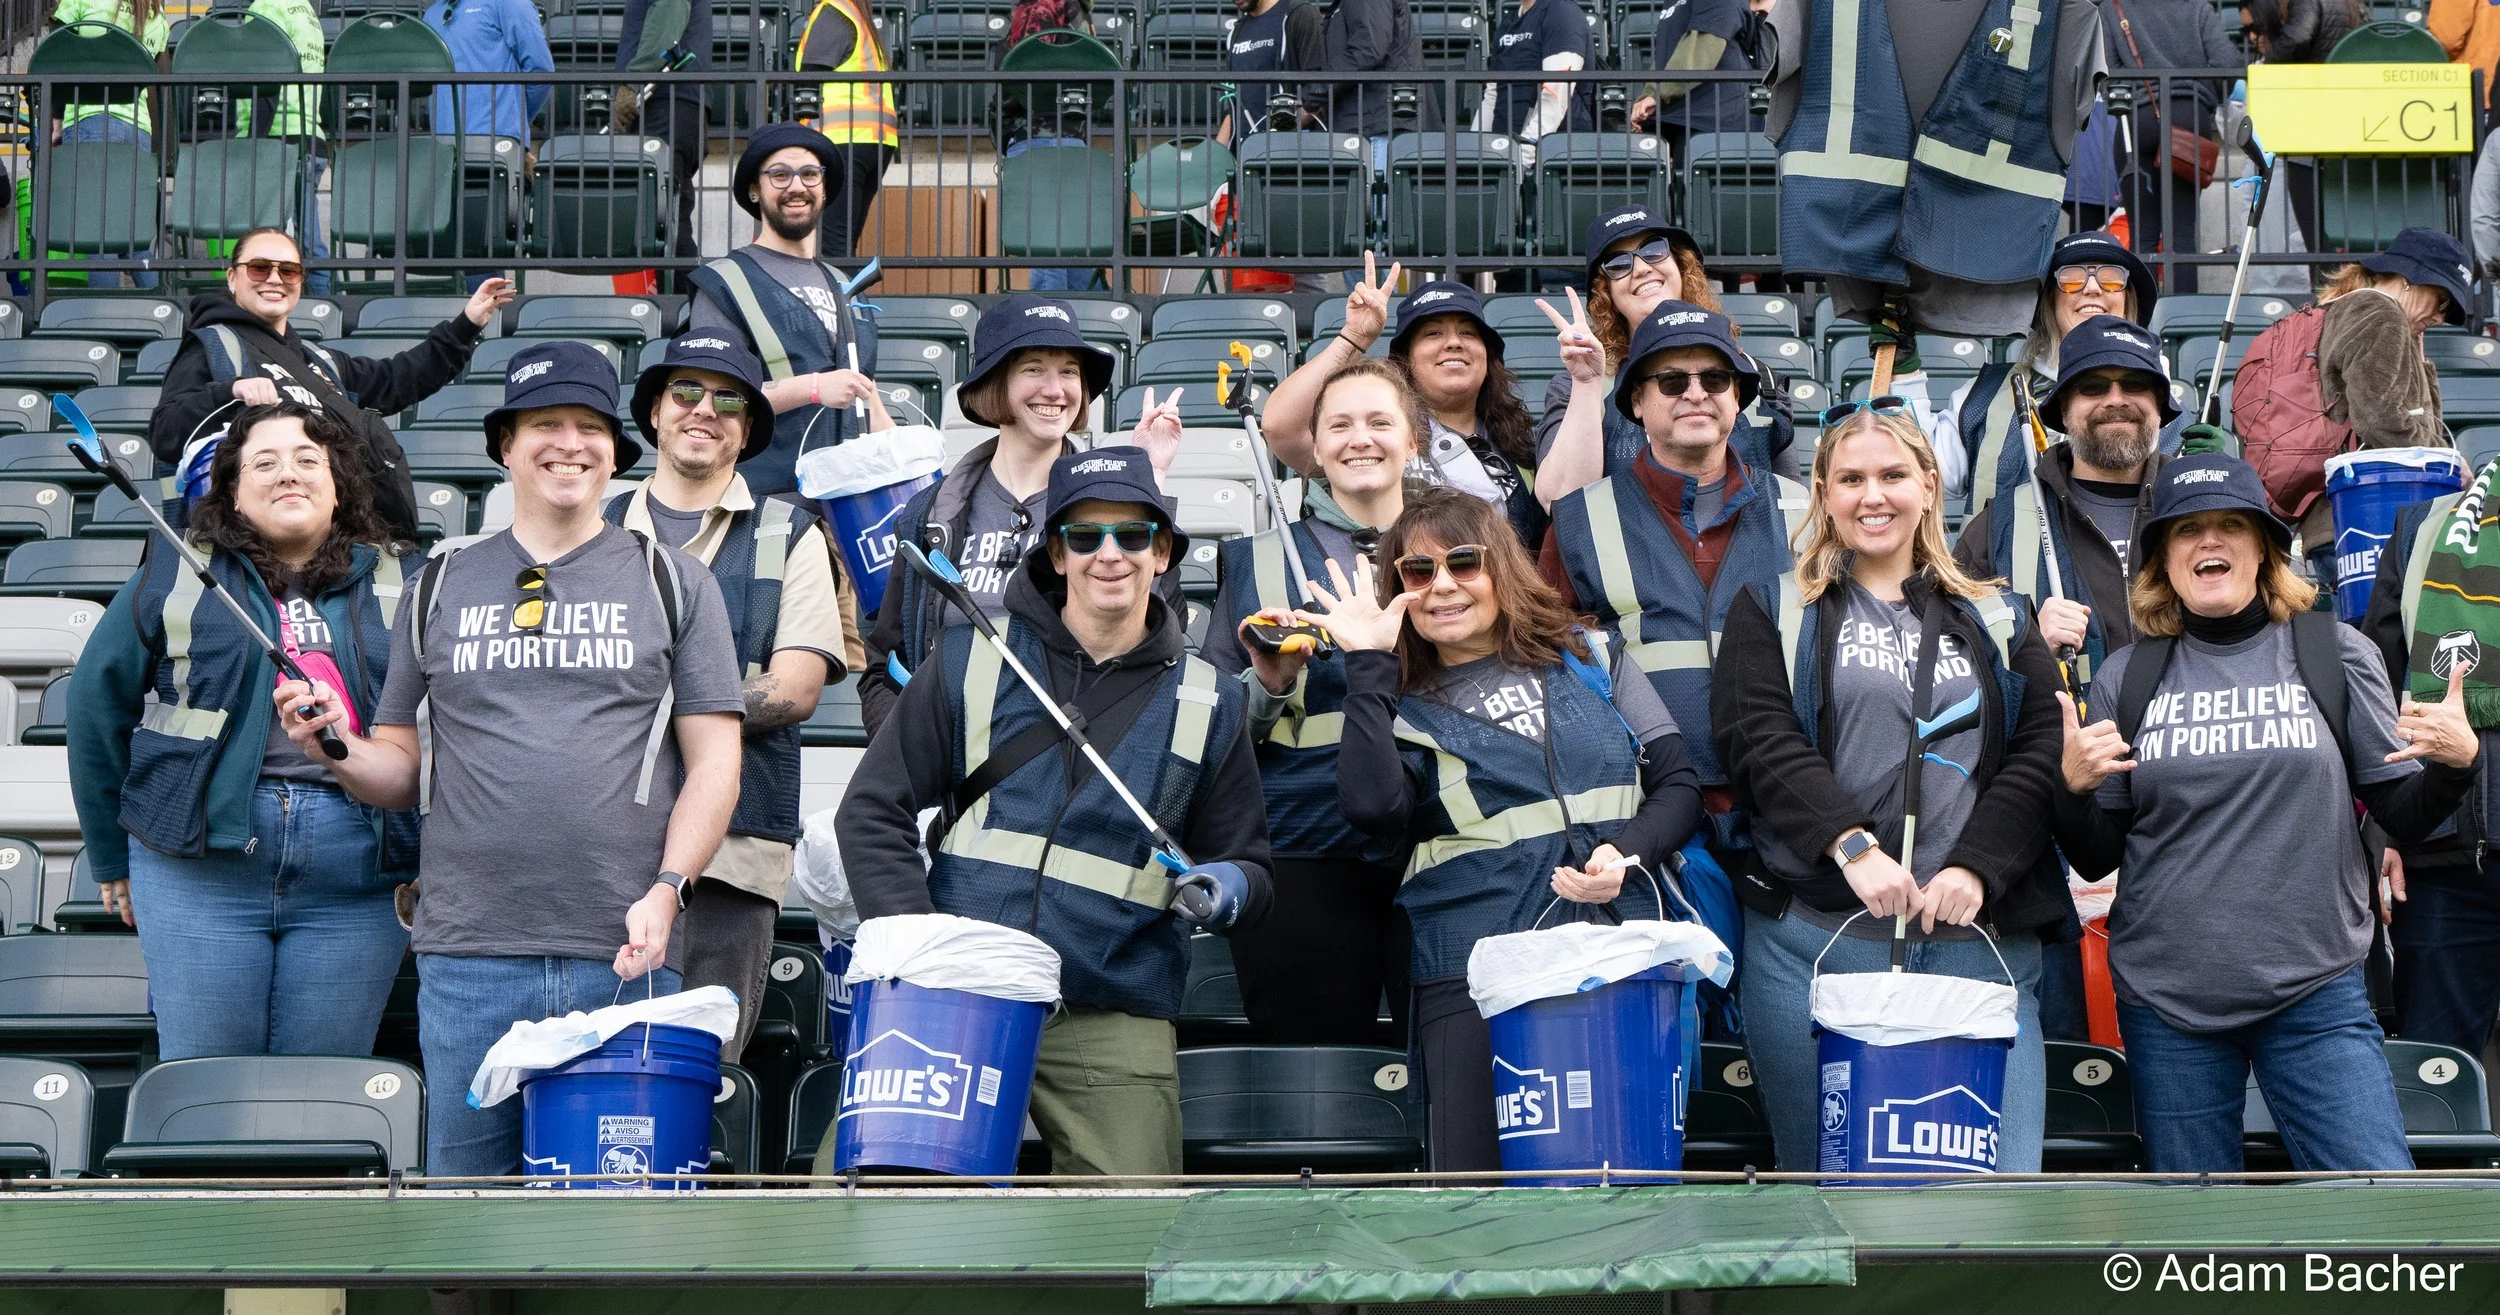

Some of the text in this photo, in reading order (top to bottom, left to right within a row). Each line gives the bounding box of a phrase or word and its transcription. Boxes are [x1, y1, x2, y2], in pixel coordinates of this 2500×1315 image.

[2383, 70, 2459, 82] SECTION C1
[2399, 100, 2459, 142] C1
[953, 306, 964, 314] 10
[1270, 307, 1276, 315] 8
[1772, 303, 1778, 311] 5
[927, 348, 938, 357] 10
[1260, 346, 1266, 354] 8
[1787, 345, 1793, 353] 5
[124, 443, 136, 451] 14
[1235, 440, 1243, 449] 8
[42, 492, 53, 500] 14
[435, 492, 448, 500] 12
[1221, 491, 1229, 500] 8
[1202, 549, 1210, 558] 8
[73, 613, 87, 624] 13
[458, 604, 504, 638] WE
[453, 636, 634, 674] IN PORTLAND
[2145, 681, 2310, 728] WE BELIEVE
[2139, 717, 2317, 762] IN PORTLAND
[783, 962, 793, 976] 9
[1737, 1066, 1749, 1080] 6
[2087, 1065, 2099, 1079] 5
[2432, 1064, 2445, 1078] 4
[1387, 1070, 1400, 1084] 7
[42, 1080, 60, 1095] 11
[372, 1078, 393, 1094] 10
[610, 1118, 650, 1126] WARNING
[615, 1127, 640, 1135] AVISO
[610, 1136, 652, 1145] AVERTISSEMENT
[1888, 1113, 1998, 1166] LOWE'S
